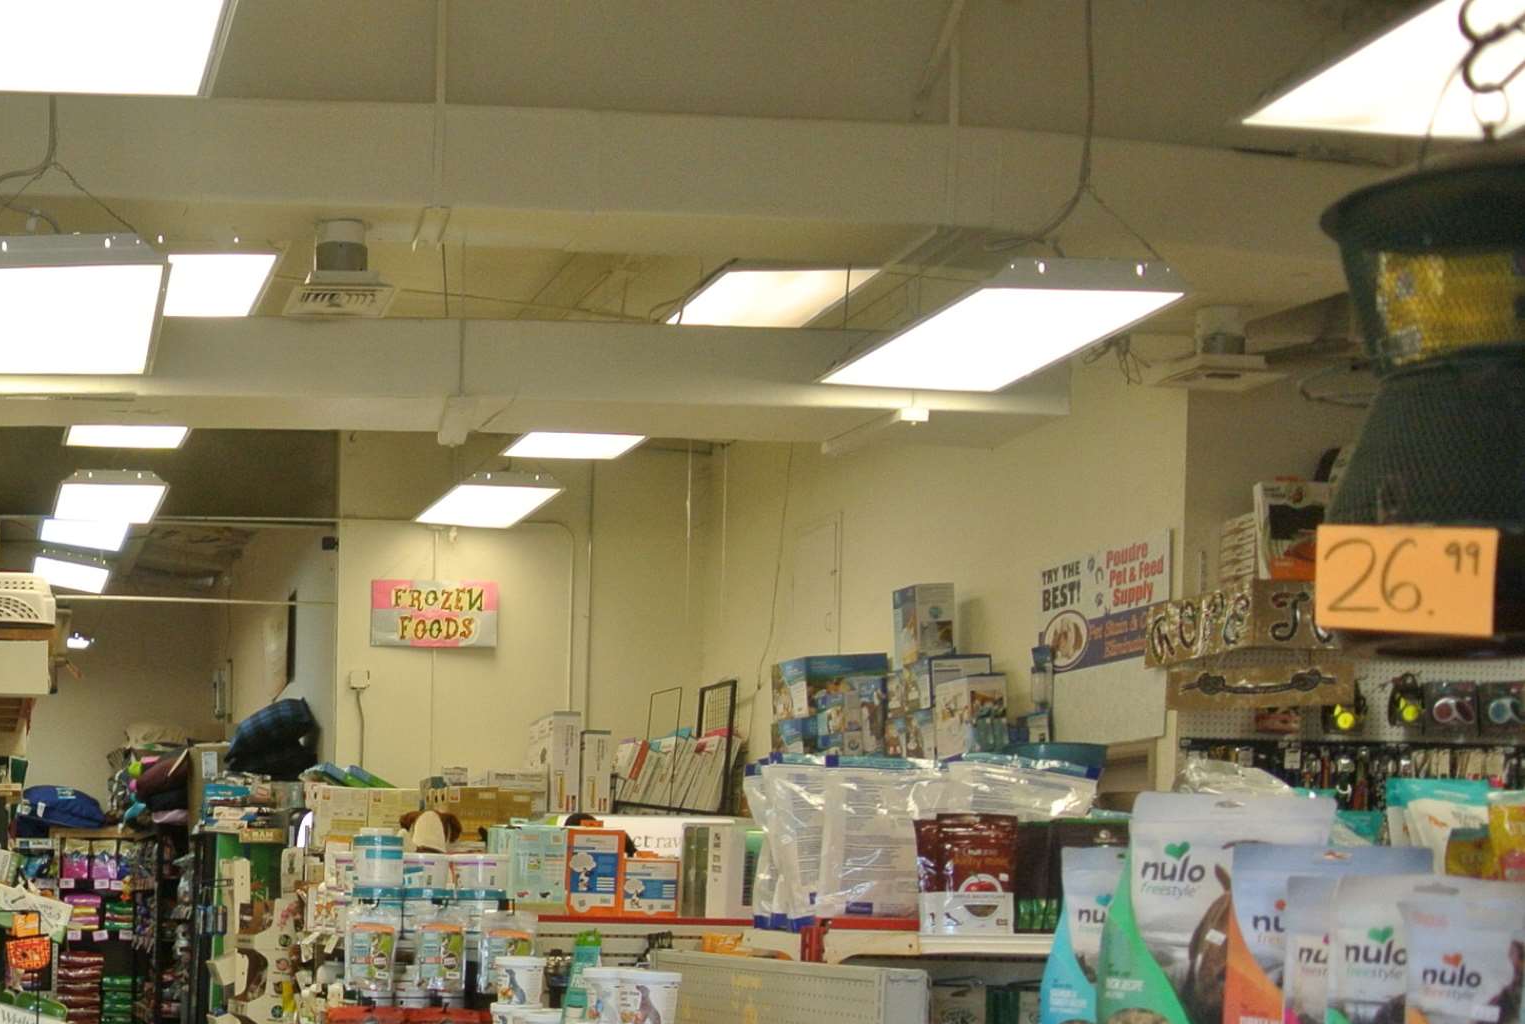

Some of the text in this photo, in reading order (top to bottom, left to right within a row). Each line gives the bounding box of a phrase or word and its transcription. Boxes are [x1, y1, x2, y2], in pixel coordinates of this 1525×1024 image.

[1106, 542, 1149, 568] Poudre
[1041, 561, 1081, 585] TRY THE
[1109, 554, 1165, 588] Pet & Feed
[393, 587, 485, 612] FROZEN
[1042, 580, 1082, 613] BEST!
[1112, 579, 1154, 609] Supply
[399, 615, 474, 640] FOODS
[1141, 855, 1207, 883] nulo
[1140, 882, 1199, 899] freestyle
[1344, 940, 1409, 967] nulo
[1422, 964, 1483, 989] nulo
